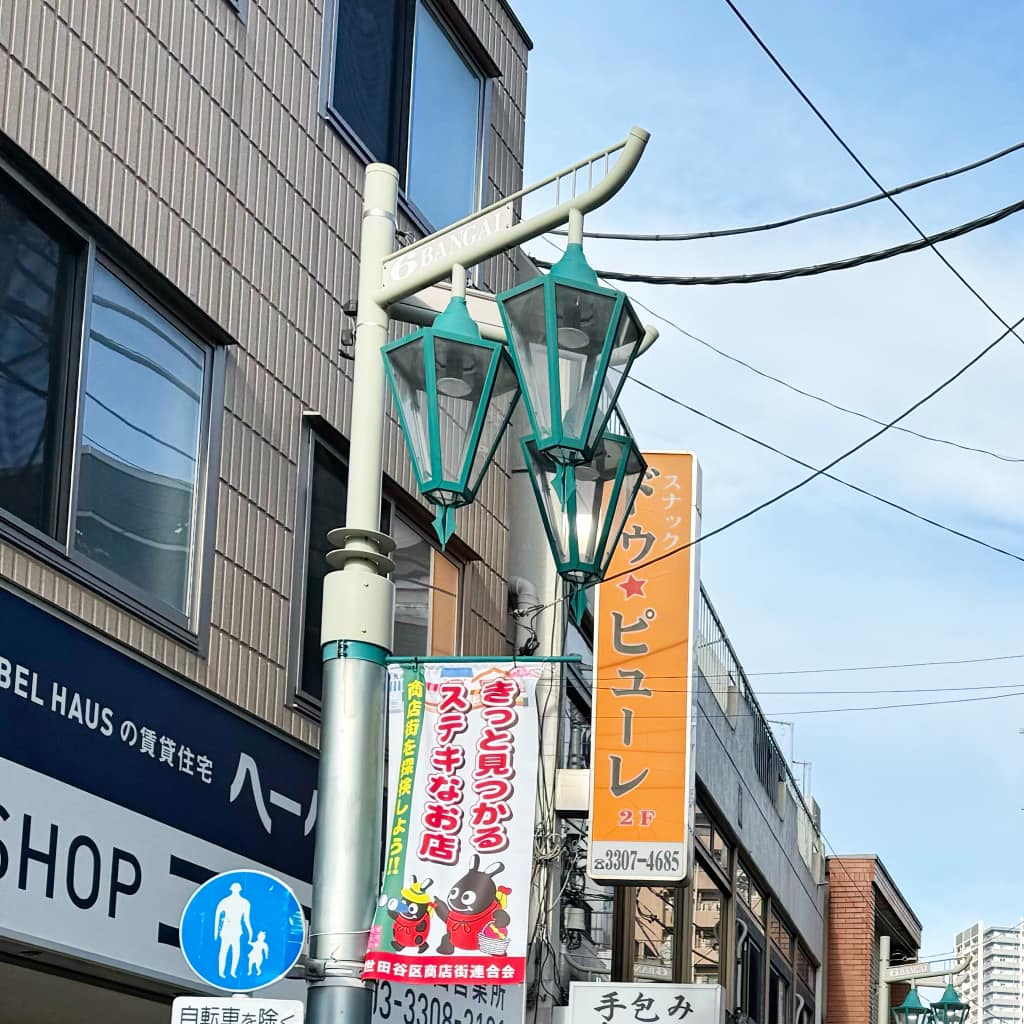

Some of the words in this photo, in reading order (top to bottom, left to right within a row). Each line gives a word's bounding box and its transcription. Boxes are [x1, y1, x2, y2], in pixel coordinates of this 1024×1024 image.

[390, 252, 417, 281] 6
[419, 213, 504, 266] BANGAI
[661, 474, 684, 551] スナック
[51, 682, 114, 737] HAUS
[120, 720, 213, 784] の賃貸住宅
[609, 608, 656, 799] ピューレ
[417, 683, 470, 863] ステキなお店
[472, 677, 519, 850] きっと見つかる
[605, 849, 680, 872] 3307-4685
[363, 960, 516, 980] 世田谷区商店街連合会
[594, 991, 694, 1022] 手包み
